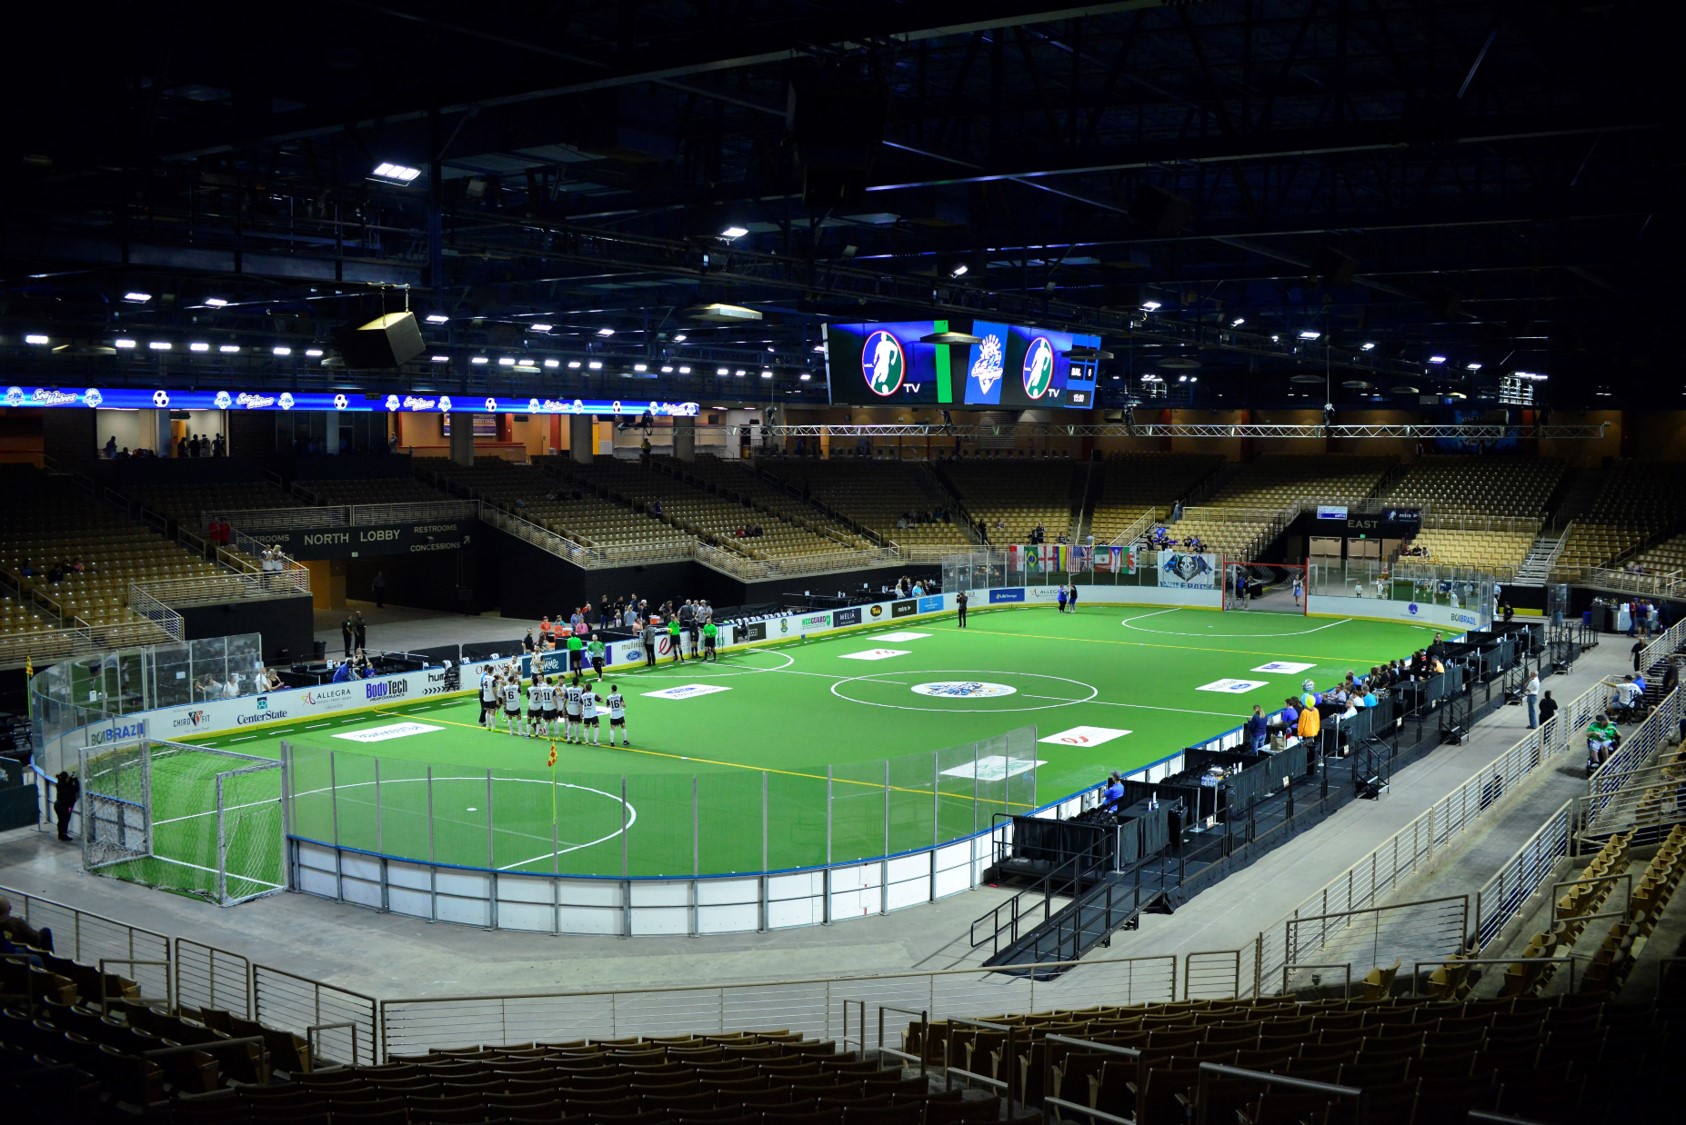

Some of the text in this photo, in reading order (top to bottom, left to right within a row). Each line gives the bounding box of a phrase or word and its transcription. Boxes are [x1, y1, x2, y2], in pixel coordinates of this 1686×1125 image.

[903, 383, 920, 393] TV
[1048, 388, 1060, 398] TV
[31, 388, 78, 406] Sea Wolves
[413, 523, 458, 534] RESTROOMS
[1347, 519, 1379, 529] EAST
[304, 528, 401, 546] NORTH LOBBY
[410, 541, 461, 553] CONCESSIONS
[627, 651, 640, 660] Ford
[366, 678, 408, 698] BodyTech
[316, 688, 351, 699] ALLEGRA
[508, 691, 514, 700] 6
[534, 692, 539, 701] 7
[543, 692, 551, 701] 11
[569, 692, 579, 702] 12
[584, 697, 592, 707] 13
[610, 699, 620, 709] 16
[202, 714, 210, 723] FIT
[237, 710, 287, 724] CenterState
